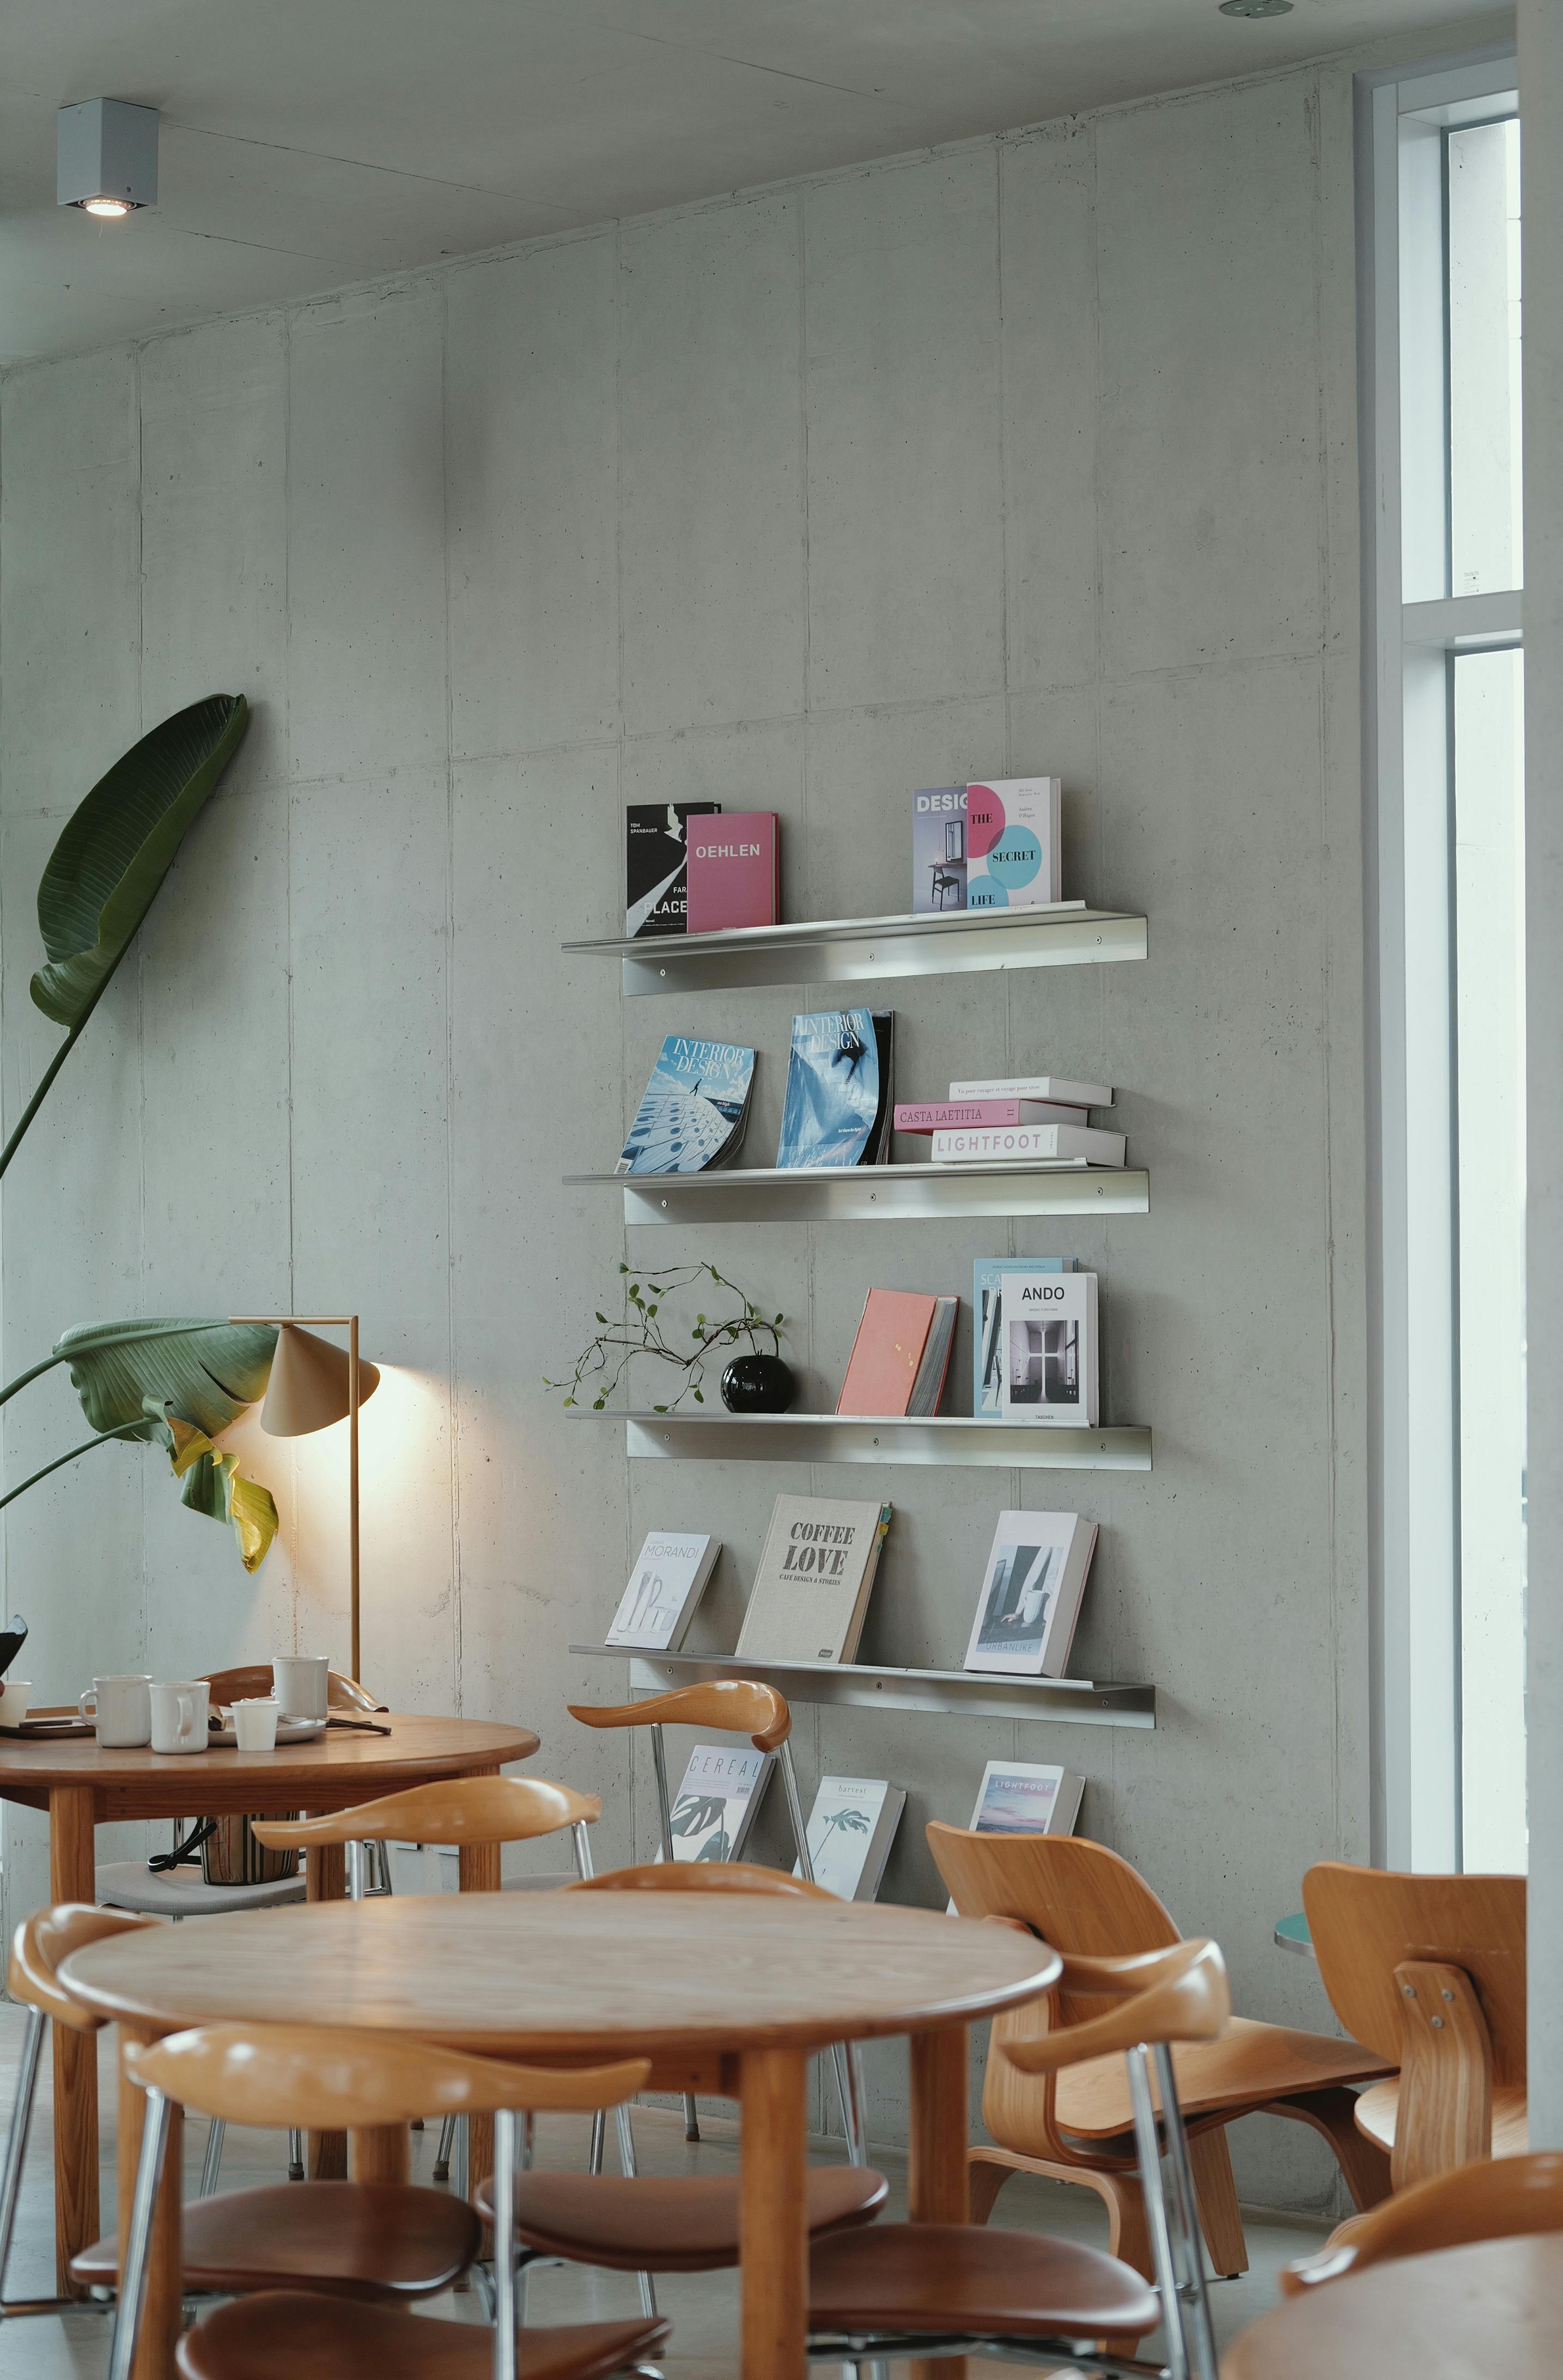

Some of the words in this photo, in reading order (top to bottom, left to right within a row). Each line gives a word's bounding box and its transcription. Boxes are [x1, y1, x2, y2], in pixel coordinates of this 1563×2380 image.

[970, 813, 993, 824] THE
[695, 843, 761, 859] OEHLEN
[993, 850, 1036, 863] SECRET
[971, 894, 996, 906] LIFE
[804, 1013, 865, 1035] INTERIOR
[810, 1030, 860, 1053] DESIGN
[672, 1038, 745, 1065] INTERIOR
[676, 1055, 731, 1079] DESIGN
[900, 1111, 933, 1122] CASTA
[935, 1109, 982, 1121] LAETITIA
[937, 1134, 1041, 1152] LIGHTFOOT
[1021, 1286, 1065, 1300] ANDO
[790, 1522, 856, 1545] COFFEE
[644, 1545, 700, 1559] MORANDI
[782, 1545, 848, 1576] LOVE
[818, 1578, 841, 1586] STORIES
[986, 1642, 1033, 1653] URBANLIKE
[690, 1756, 759, 1777] CEREAL
[838, 1784, 866, 1794] harvest
[995, 1780, 1049, 1792] LIGHTFOOT
